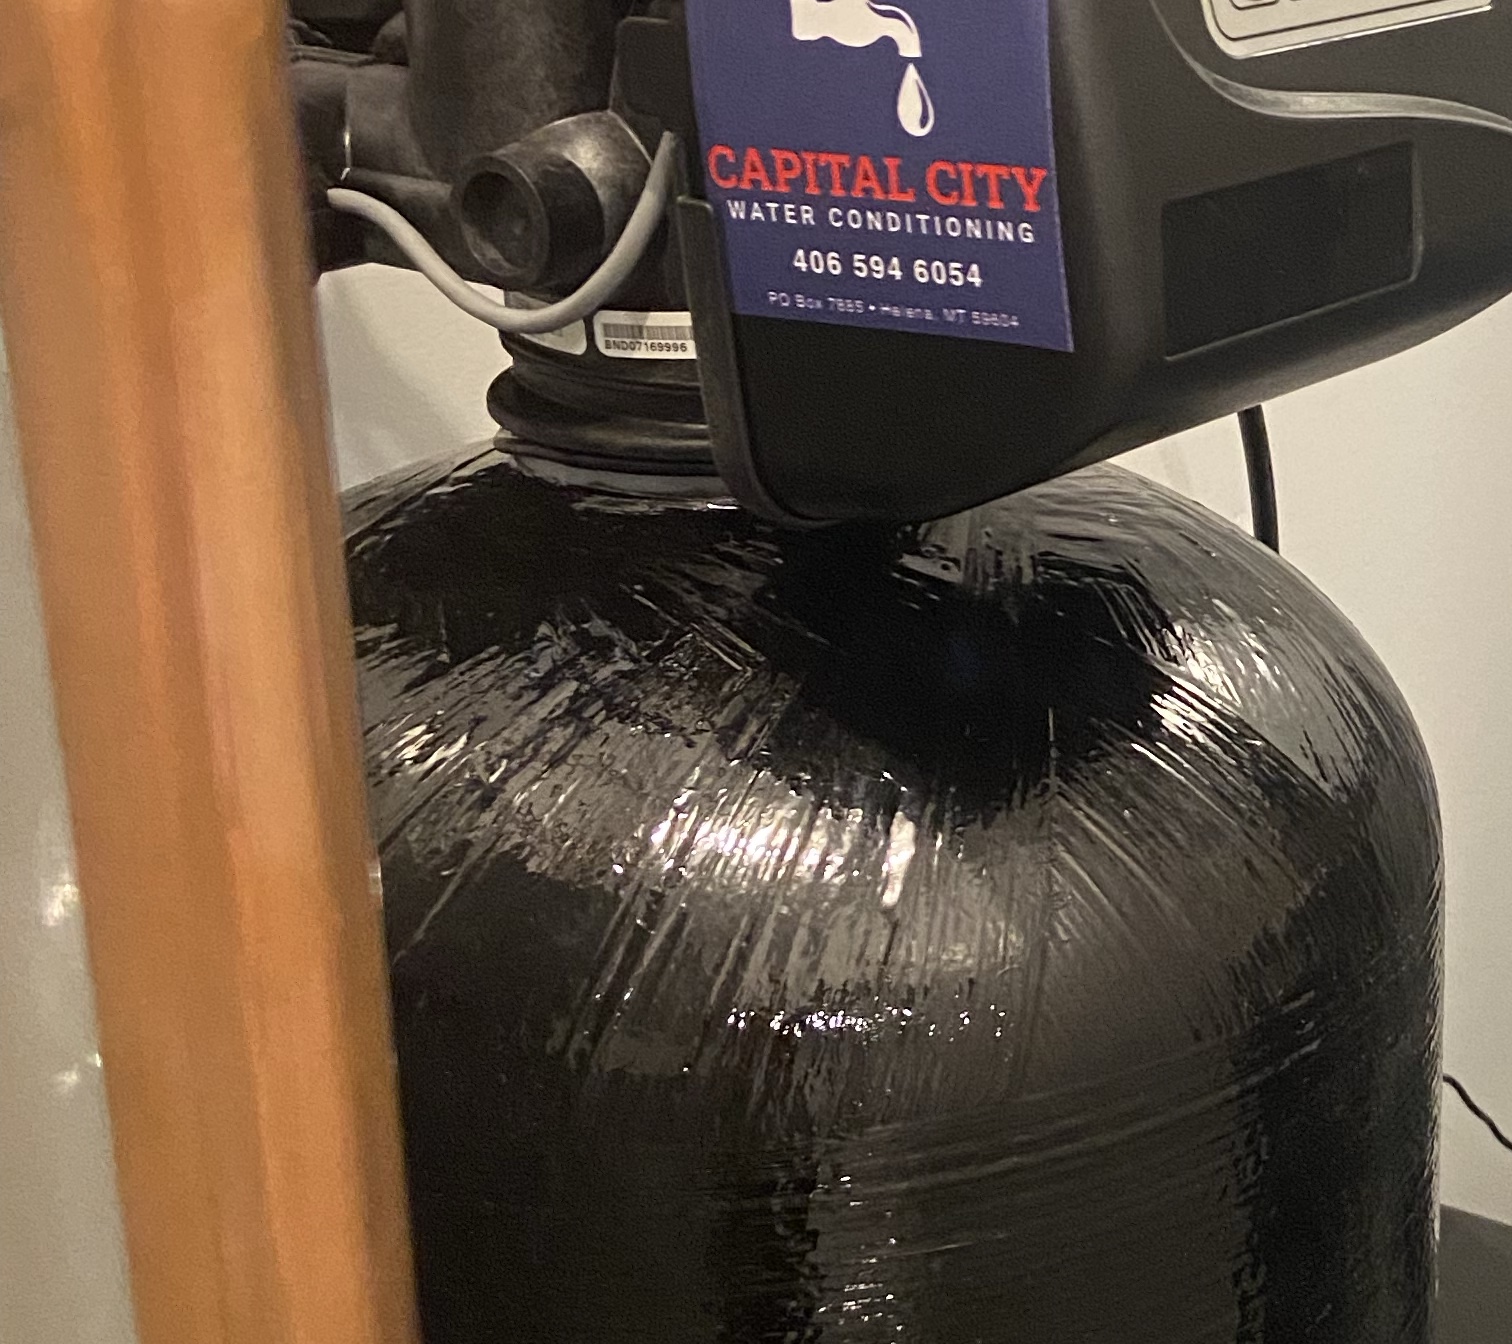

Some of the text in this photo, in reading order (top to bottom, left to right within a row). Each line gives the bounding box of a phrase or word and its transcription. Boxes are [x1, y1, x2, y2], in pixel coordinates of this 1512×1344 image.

[707, 143, 1047, 212] CAPITAL CITY
[727, 199, 1036, 244] WATER CONDITIONING
[793, 248, 984, 288] 406 594 6054
[767, 291, 791, 307] PO
[795, 293, 822, 309] Box
[943, 308, 967, 324] MT
[604, 339, 688, 353] BND07169996
